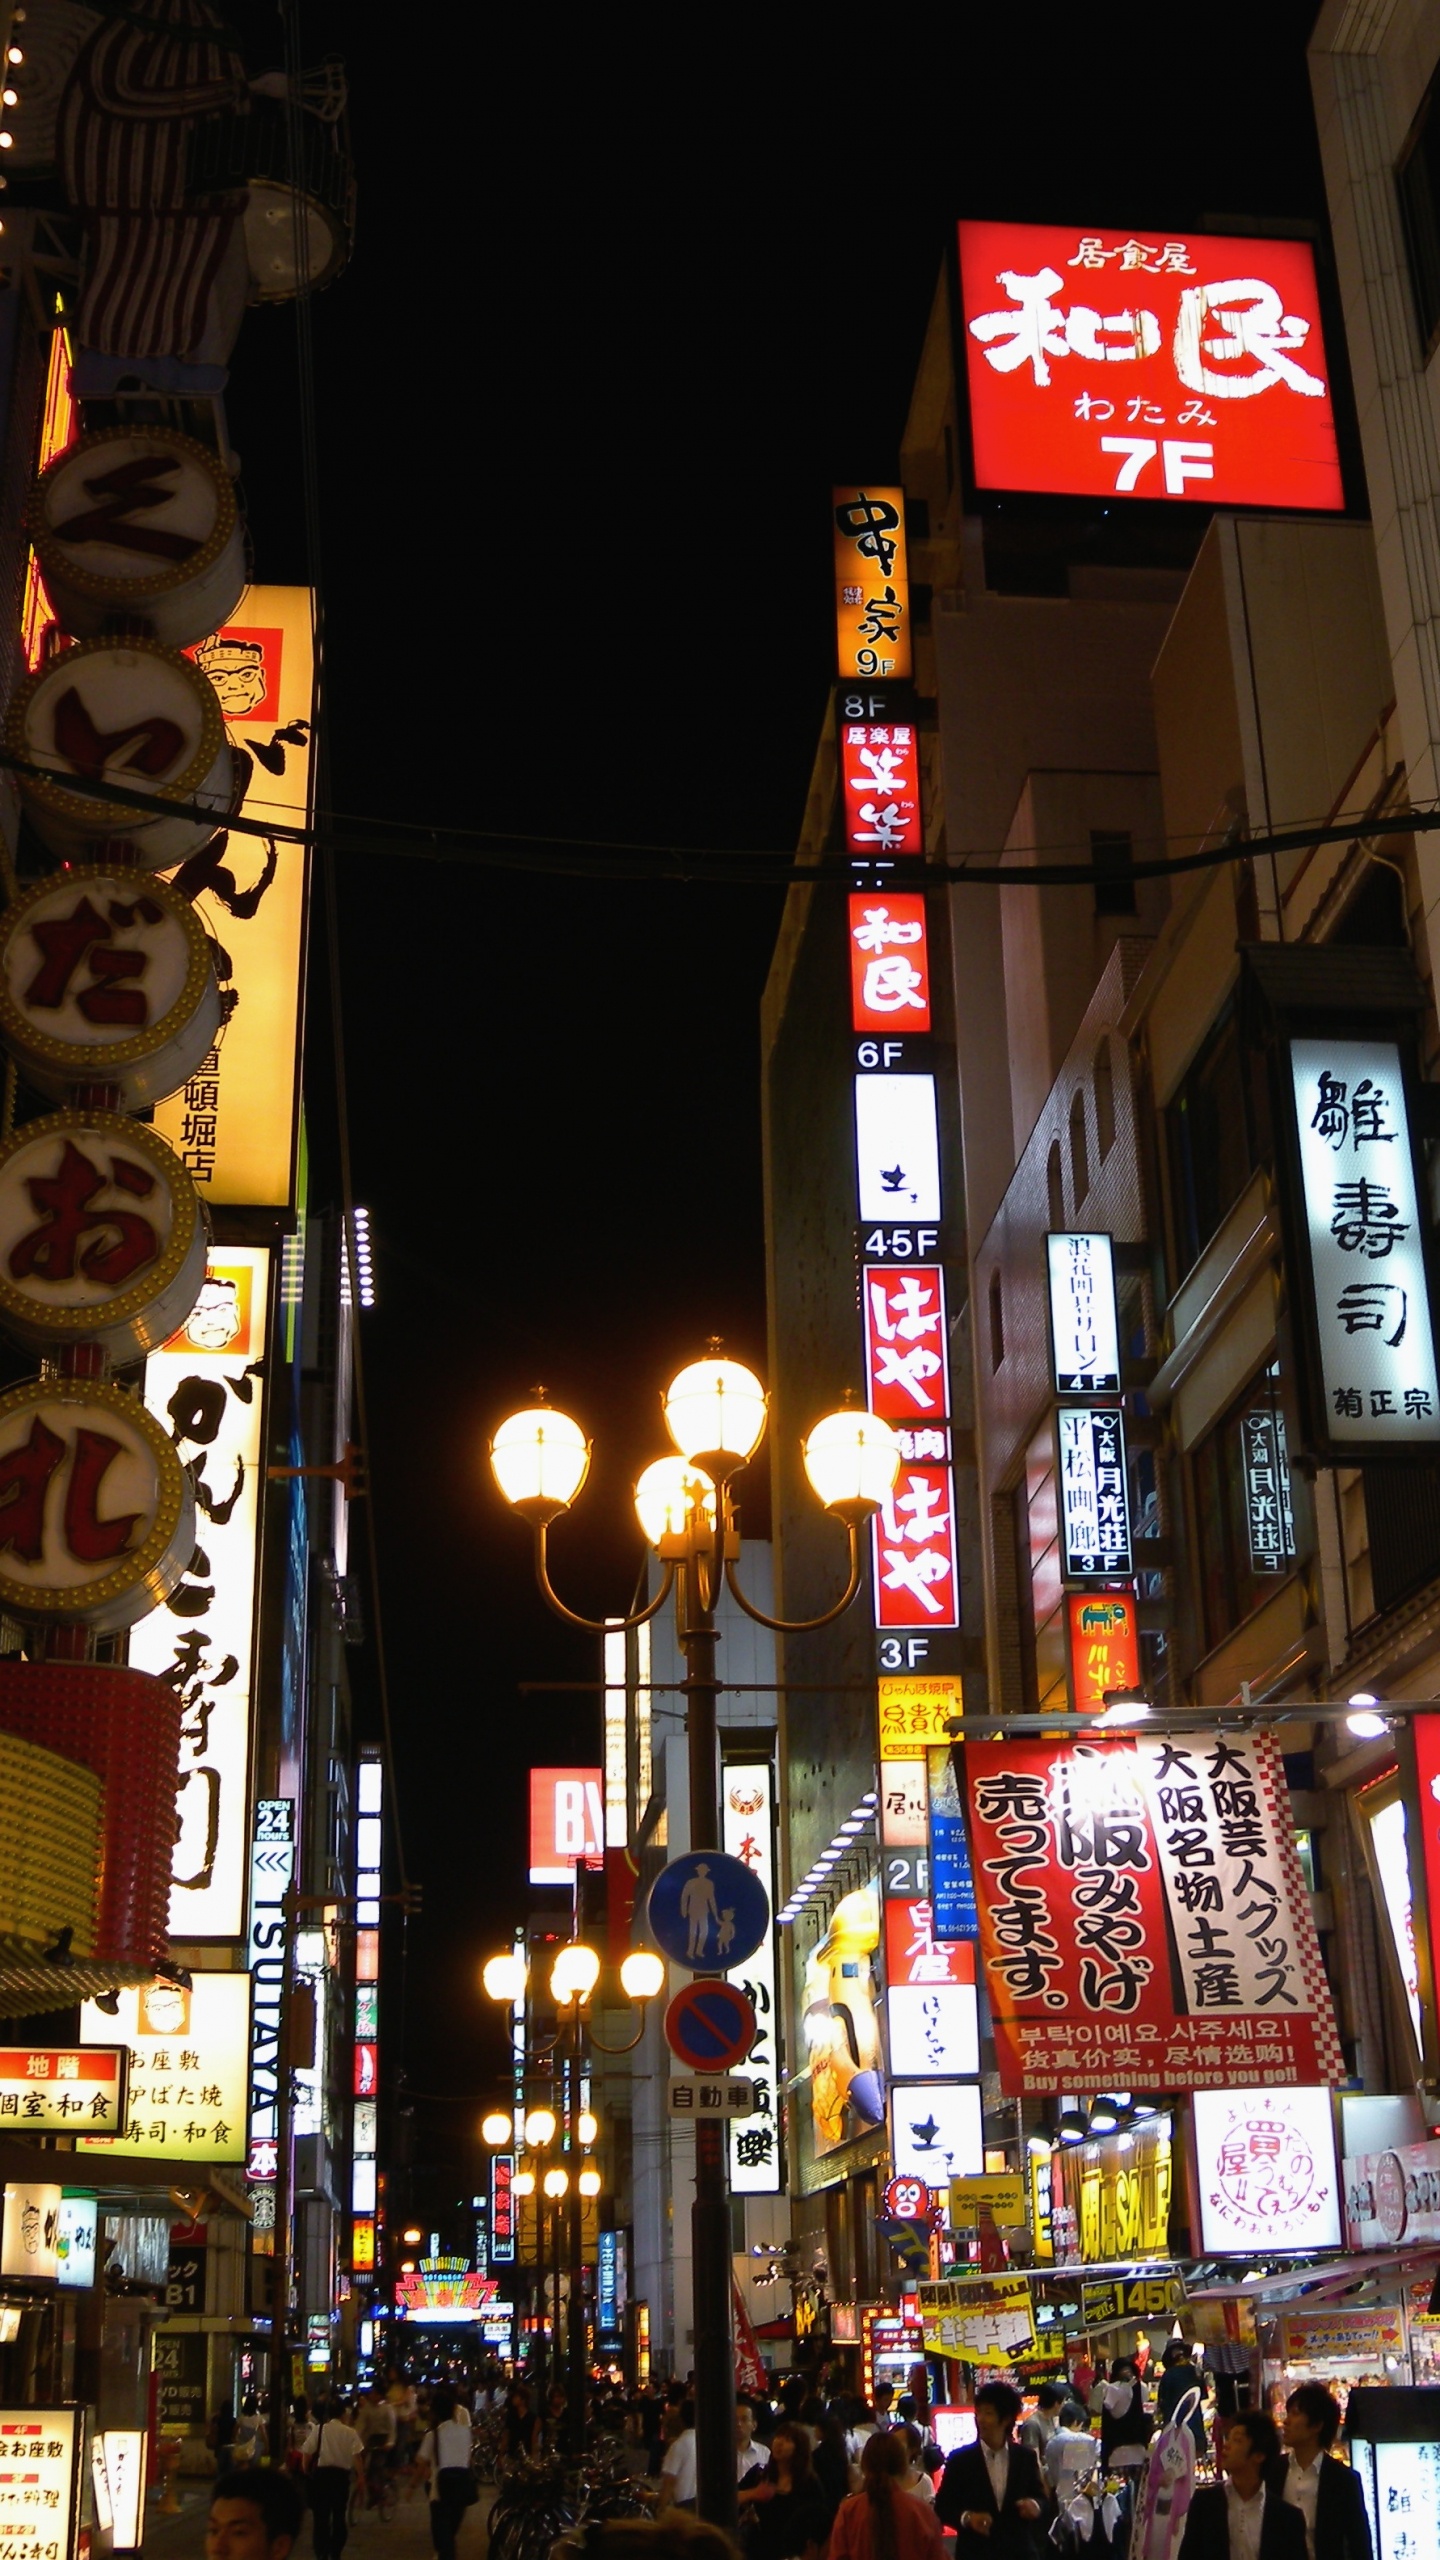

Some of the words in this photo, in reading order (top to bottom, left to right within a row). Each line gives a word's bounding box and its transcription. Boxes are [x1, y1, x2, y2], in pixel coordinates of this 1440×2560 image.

[1067, 238, 1197, 275] 居食屋
[968, 266, 1326, 399] 和民
[1074, 391, 1218, 426] わたみ
[1101, 436, 1214, 494] 7F
[856, 648, 896, 675] 9F
[844, 695, 887, 719] 8F
[847, 726, 912, 745] 居楽屋
[853, 907, 927, 1012] 和民
[857, 1041, 904, 1069] 6F
[870, 1276, 942, 1409] はや
[1070, 1374, 1107, 1391] 4F
[1332, 1388, 1435, 1420] 菊正宗
[880, 1475, 952, 1615] はや
[1081, 1555, 1118, 1572] 3F
[879, 1638, 930, 1668] 3F
[257, 1800, 291, 1811] OPEN
[256, 1810, 290, 1832] 24
[256, 1831, 290, 1841] hours
[1153, 1742, 1245, 2008] 大阪名物土産
[1205, 1741, 1299, 2007] 大阪芸人グッズ
[976, 1772, 1068, 2009] 売ってます。
[27, 2054, 80, 2079] 地階
[129, 2050, 201, 2071] お座敷
[1023, 2075, 1059, 2091] Buy
[1062, 2070, 1161, 2090] something
[1164, 2068, 1224, 2086] before
[1226, 2070, 1258, 2087] you
[672, 2083, 750, 2109] 自動車
[250, 2142, 278, 2176] 本
[164, 2283, 196, 2306] B1
